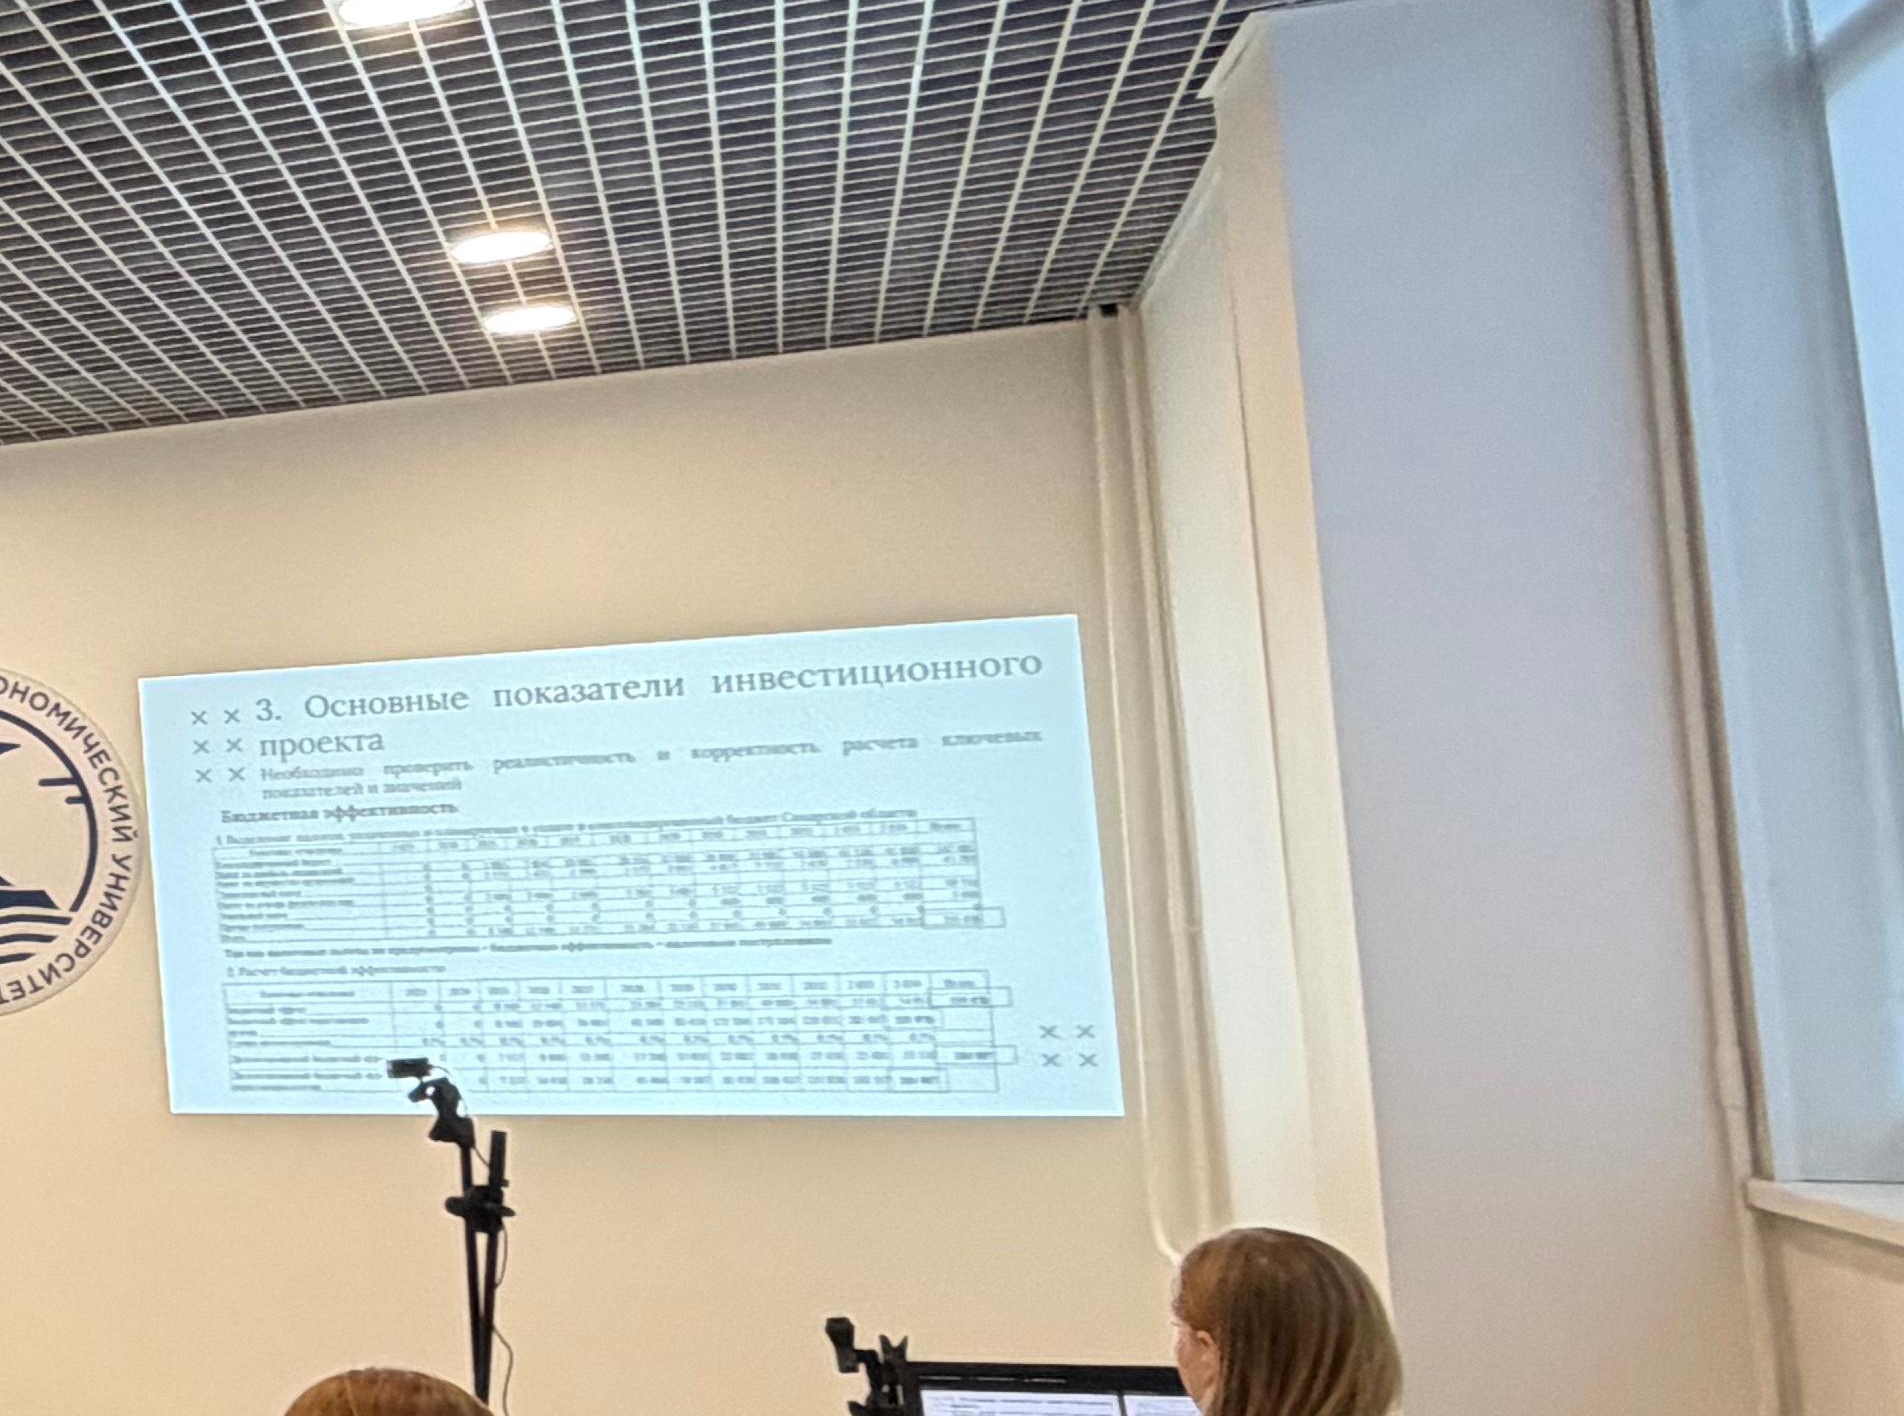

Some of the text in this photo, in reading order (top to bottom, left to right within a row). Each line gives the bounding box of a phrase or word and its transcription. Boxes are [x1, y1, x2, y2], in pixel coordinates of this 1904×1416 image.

[255, 654, 1043, 722] 3. Основные показатели инвестиционного
[259, 732, 385, 763] проекта
